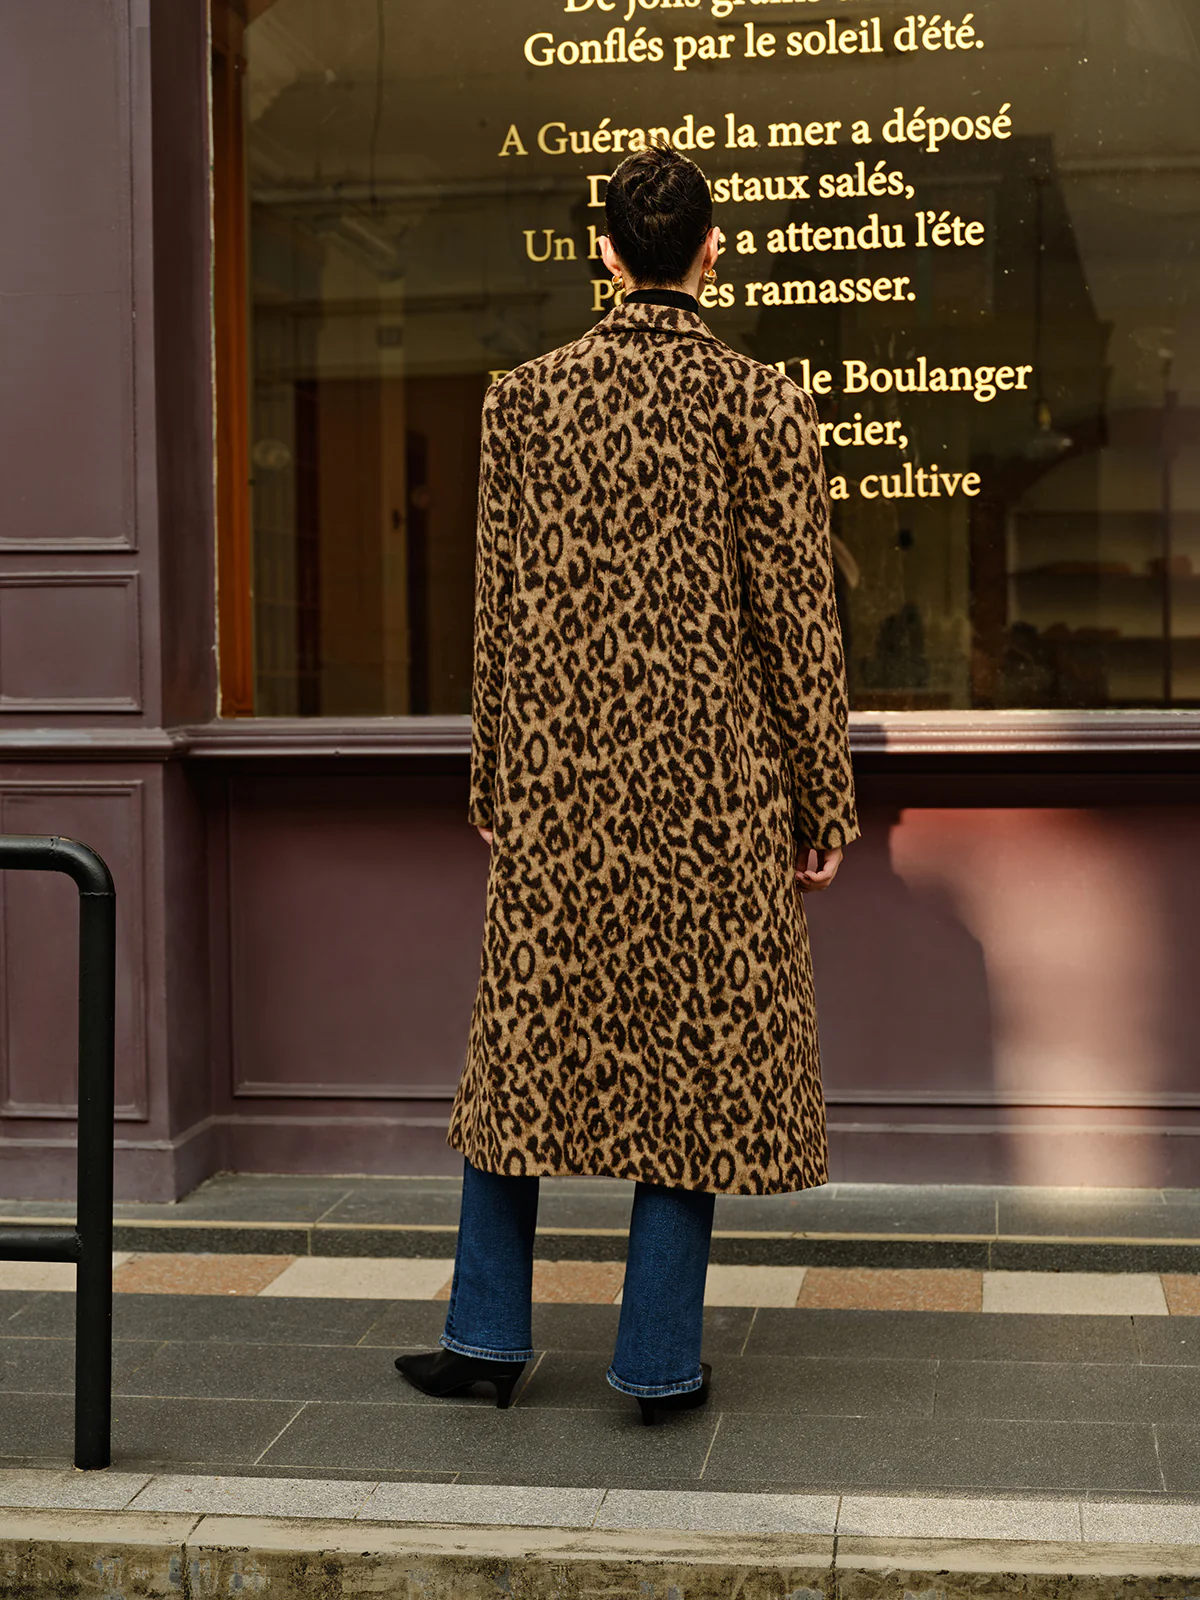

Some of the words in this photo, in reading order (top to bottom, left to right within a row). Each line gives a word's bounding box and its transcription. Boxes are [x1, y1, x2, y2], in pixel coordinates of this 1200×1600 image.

[523, 26, 665, 67] Gonflés
[672, 33, 736, 72] par
[743, 21, 777, 58] le
[786, 16, 884, 57] soleil
[893, 12, 985, 52] d’été.
[498, 124, 529, 157] A
[537, 113, 716, 154] Guérande
[724, 112, 760, 149] la
[767, 120, 842, 148] mer
[851, 119, 873, 145] a
[881, 102, 1012, 153] déposé
[706, 172, 811, 203] staux
[818, 160, 915, 200] salés,
[522, 229, 577, 262] Un
[736, 229, 758, 255] a
[766, 212, 907, 254] attendu
[914, 210, 985, 248] l’éte
[699, 283, 736, 309] es
[744, 276, 916, 307] ramasser.
[799, 358, 832, 395] le
[842, 356, 1033, 403] Boulanger
[817, 412, 909, 450] rcier,
[829, 475, 850, 500] a
[859, 461, 981, 500] cultive
